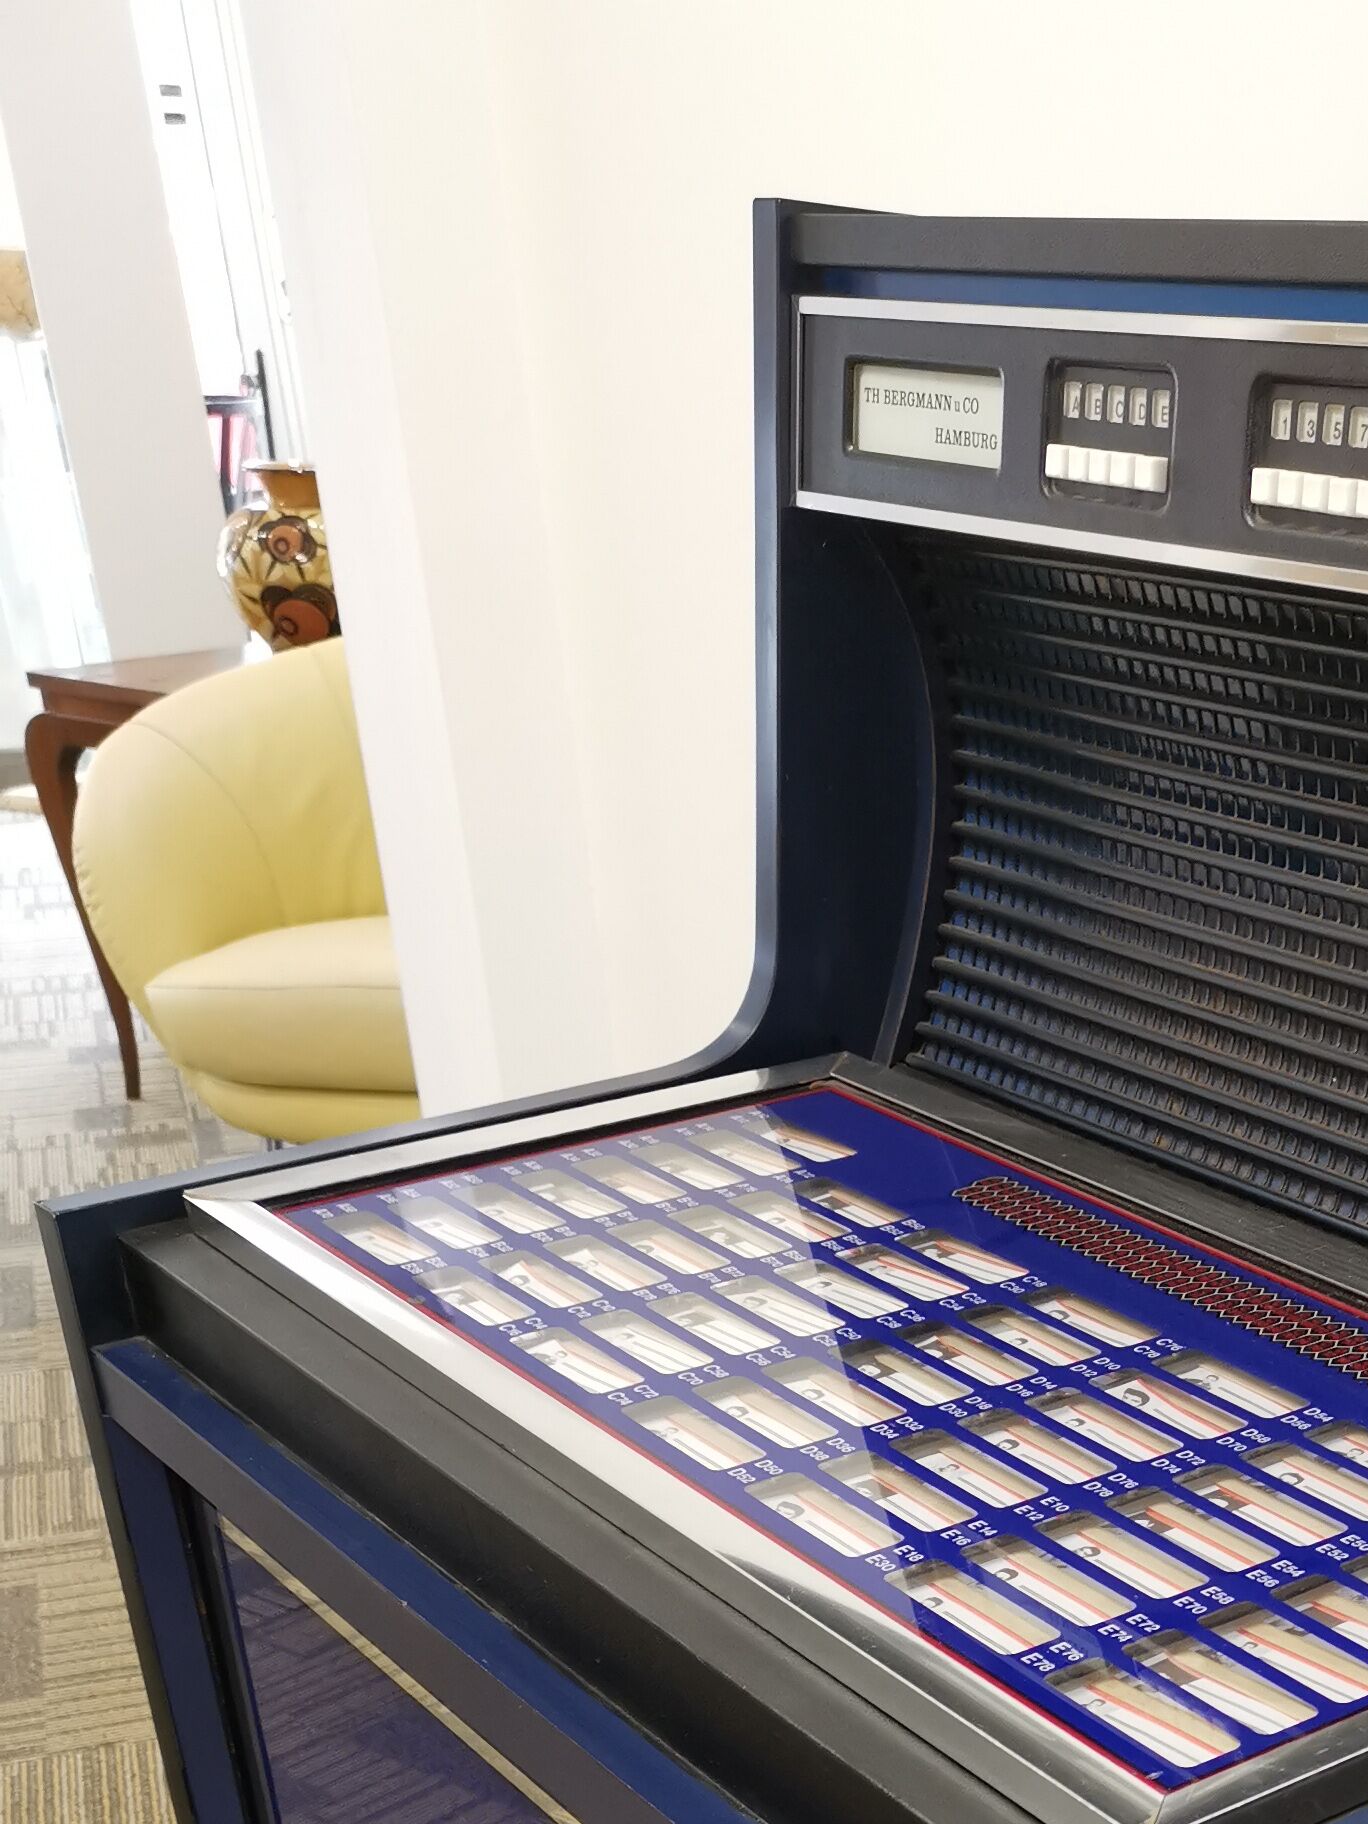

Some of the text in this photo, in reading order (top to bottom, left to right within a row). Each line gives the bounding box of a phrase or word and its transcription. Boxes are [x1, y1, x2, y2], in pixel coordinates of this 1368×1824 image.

[864, 387, 880, 403] TH
[883, 389, 953, 412] BERGMANN
[962, 396, 979, 414] CO
[1071, 395, 1169, 422] A B C D E
[1282, 416, 1288, 435] 1
[1306, 419, 1315, 438] 3
[1333, 421, 1342, 439] 5
[1360, 424, 1368, 442] 7
[935, 427, 998, 450] HAMBURG
[1133, 1344, 1161, 1359] C78
[1155, 1337, 1185, 1352] C76
[1069, 1363, 1098, 1378] D12
[1092, 1356, 1122, 1371] D10
[1004, 1382, 1034, 1398] D16
[1029, 1375, 1058, 1390] D14
[937, 1402, 968, 1418] D30
[963, 1395, 994, 1411] D18
[894, 1415, 925, 1432] D32
[1279, 1414, 1312, 1431] D56
[1302, 1406, 1334, 1423] D54
[869, 1423, 900, 1439] D34
[1239, 1427, 1272, 1444] D58
[825, 1437, 856, 1453] D36
[1215, 1435, 1248, 1452] D70
[799, 1445, 830, 1462] D38
[1174, 1449, 1206, 1466] D72
[753, 1458, 784, 1476] D50
[1150, 1457, 1183, 1474] D74
[726, 1467, 757, 1484] D52
[1107, 1472, 1140, 1489] D76
[1082, 1480, 1114, 1498] D78
[1012, 1504, 1045, 1522] E12
[1039, 1495, 1070, 1513] E10
[939, 1528, 972, 1546] E16
[967, 1519, 998, 1537] E14
[893, 1544, 923, 1563] E18
[1314, 1542, 1350, 1561] E52
[864, 1553, 897, 1572] E30
[1270, 1559, 1306, 1578] E54
[1245, 1568, 1280, 1588] E56
[1199, 1585, 1235, 1605] E58
[1172, 1595, 1208, 1615] E70
[1125, 1613, 1161, 1633] E72
[1097, 1623, 1133, 1643] E74
[1048, 1641, 1085, 1662] E76
[1020, 1652, 1056, 1672] E78
